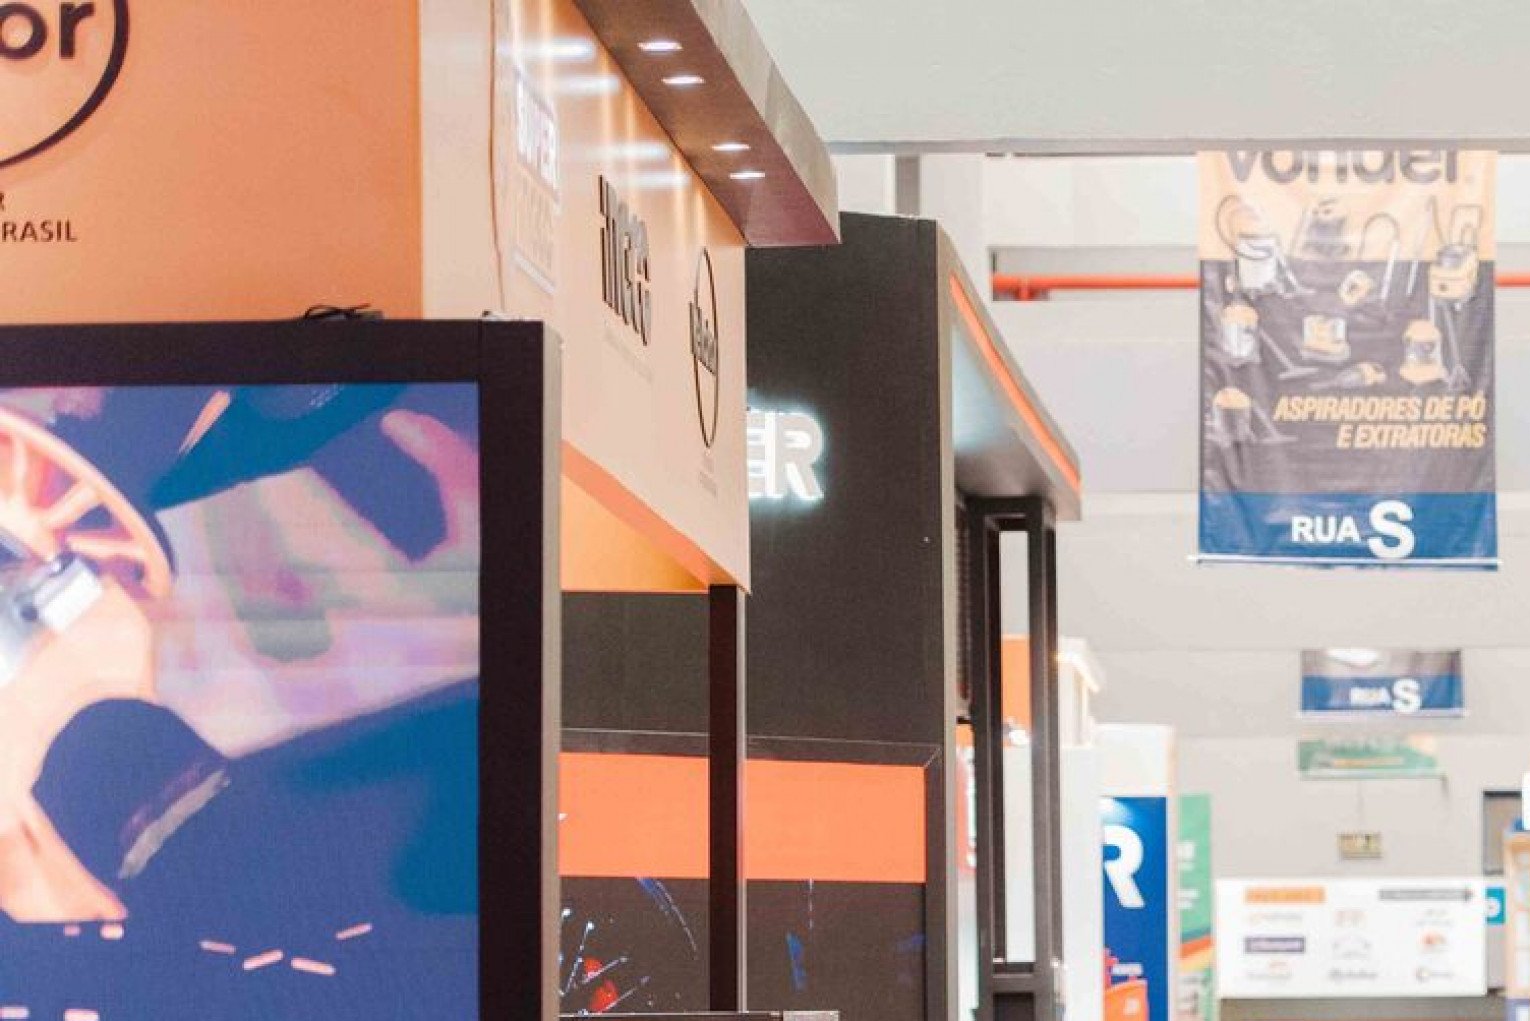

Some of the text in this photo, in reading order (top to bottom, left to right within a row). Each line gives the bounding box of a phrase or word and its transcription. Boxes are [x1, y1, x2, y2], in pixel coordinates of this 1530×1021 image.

[0, 2, 95, 60] or
[0, 219, 78, 242] RASIL
[1273, 390, 1487, 421] ASPIRADORES DE PÓ
[747, 408, 826, 500] ER
[1336, 422, 1488, 448] E EXTRATORAS
[1291, 500, 1416, 559] RUA S
[1391, 677, 1422, 713] S
[1103, 824, 1146, 909] R
